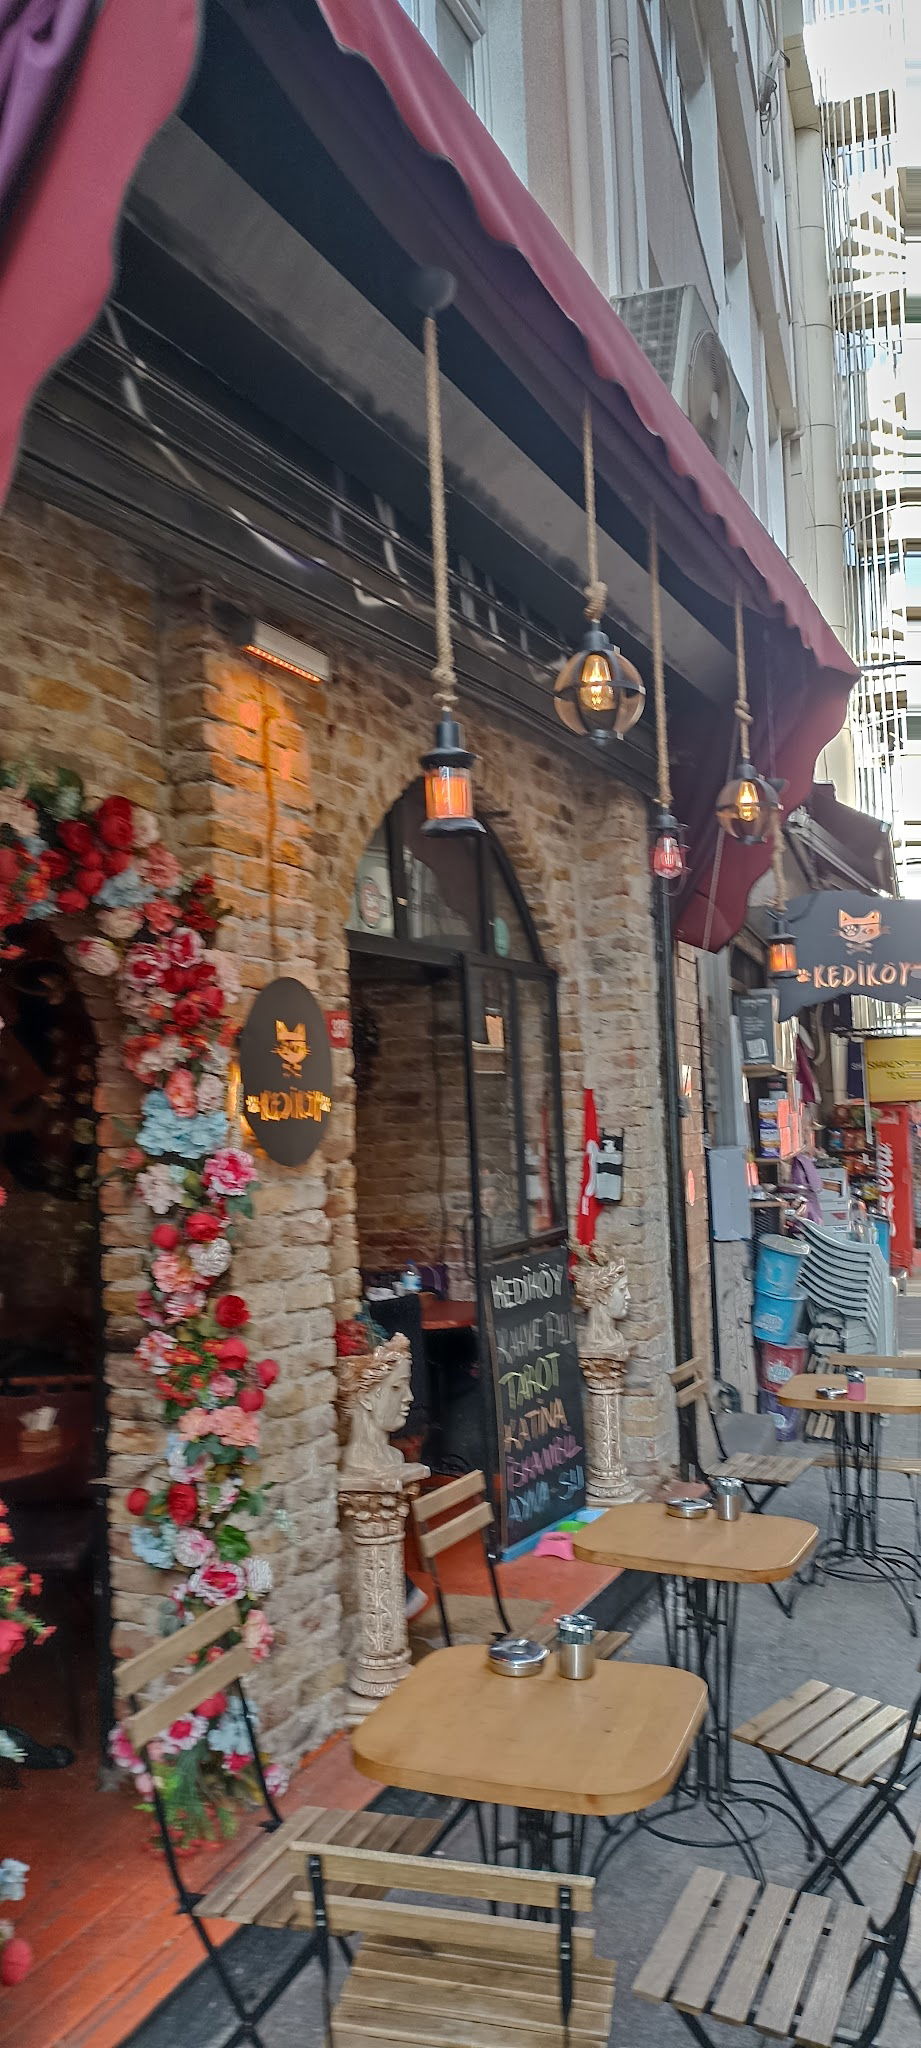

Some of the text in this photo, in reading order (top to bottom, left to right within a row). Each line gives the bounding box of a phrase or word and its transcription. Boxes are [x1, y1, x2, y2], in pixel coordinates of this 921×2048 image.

[813, 960, 909, 988] KEDİKÖY
[491, 1262, 563, 1309] KEDİKÖY
[498, 1352, 560, 1410] TAROT
